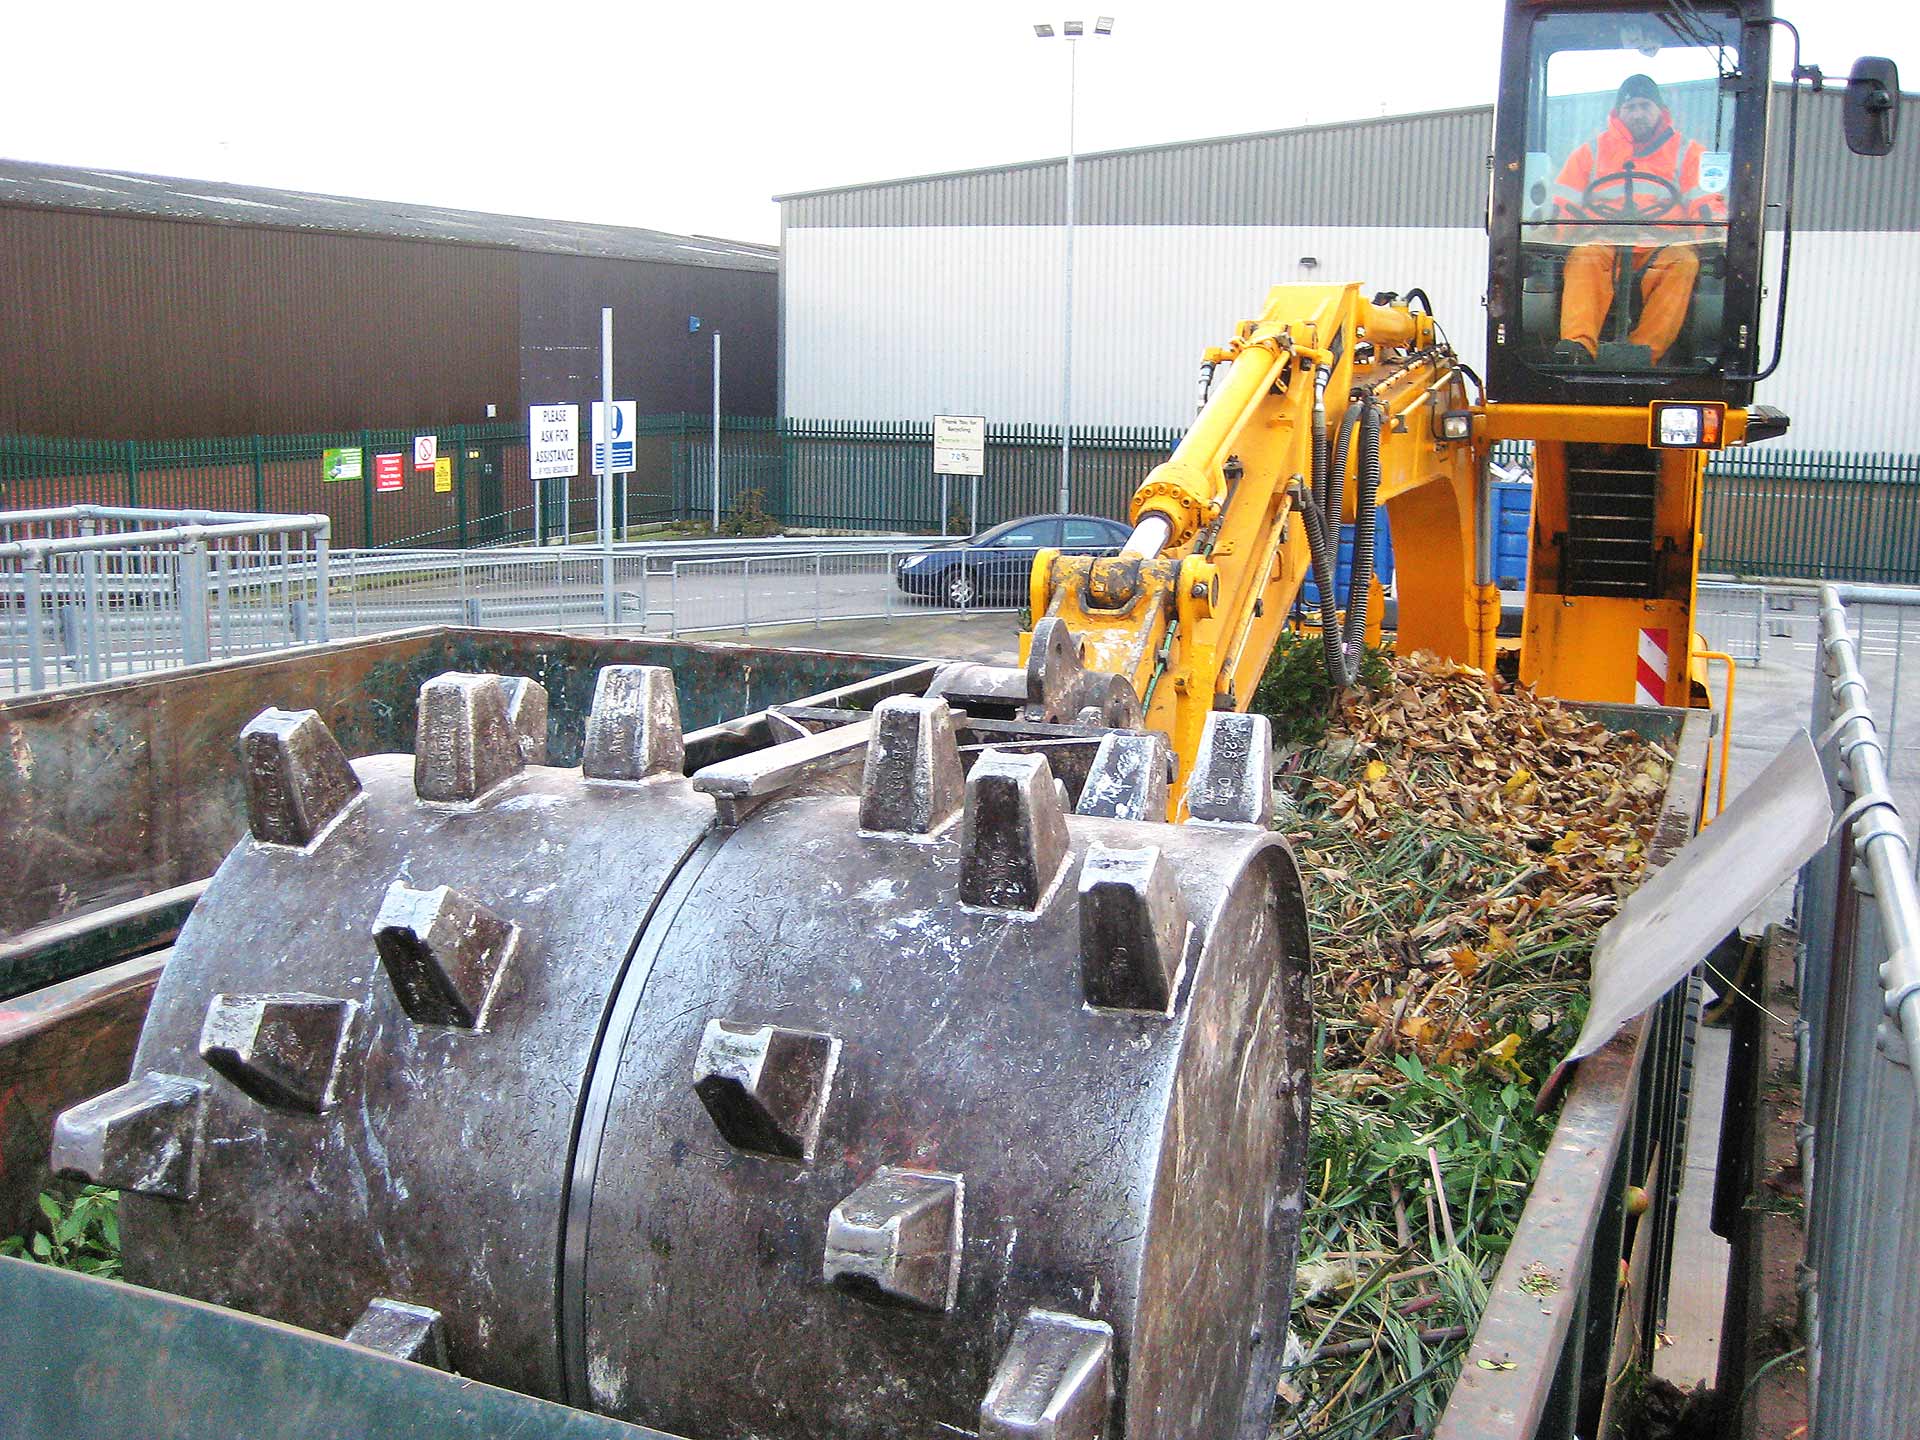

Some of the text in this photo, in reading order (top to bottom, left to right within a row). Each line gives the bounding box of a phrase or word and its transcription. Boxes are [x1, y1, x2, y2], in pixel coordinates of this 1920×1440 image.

[544, 410, 566, 422] PLEASE
[541, 429, 569, 443] ASK FOR
[536, 449, 574, 462] ASSISTANCE
